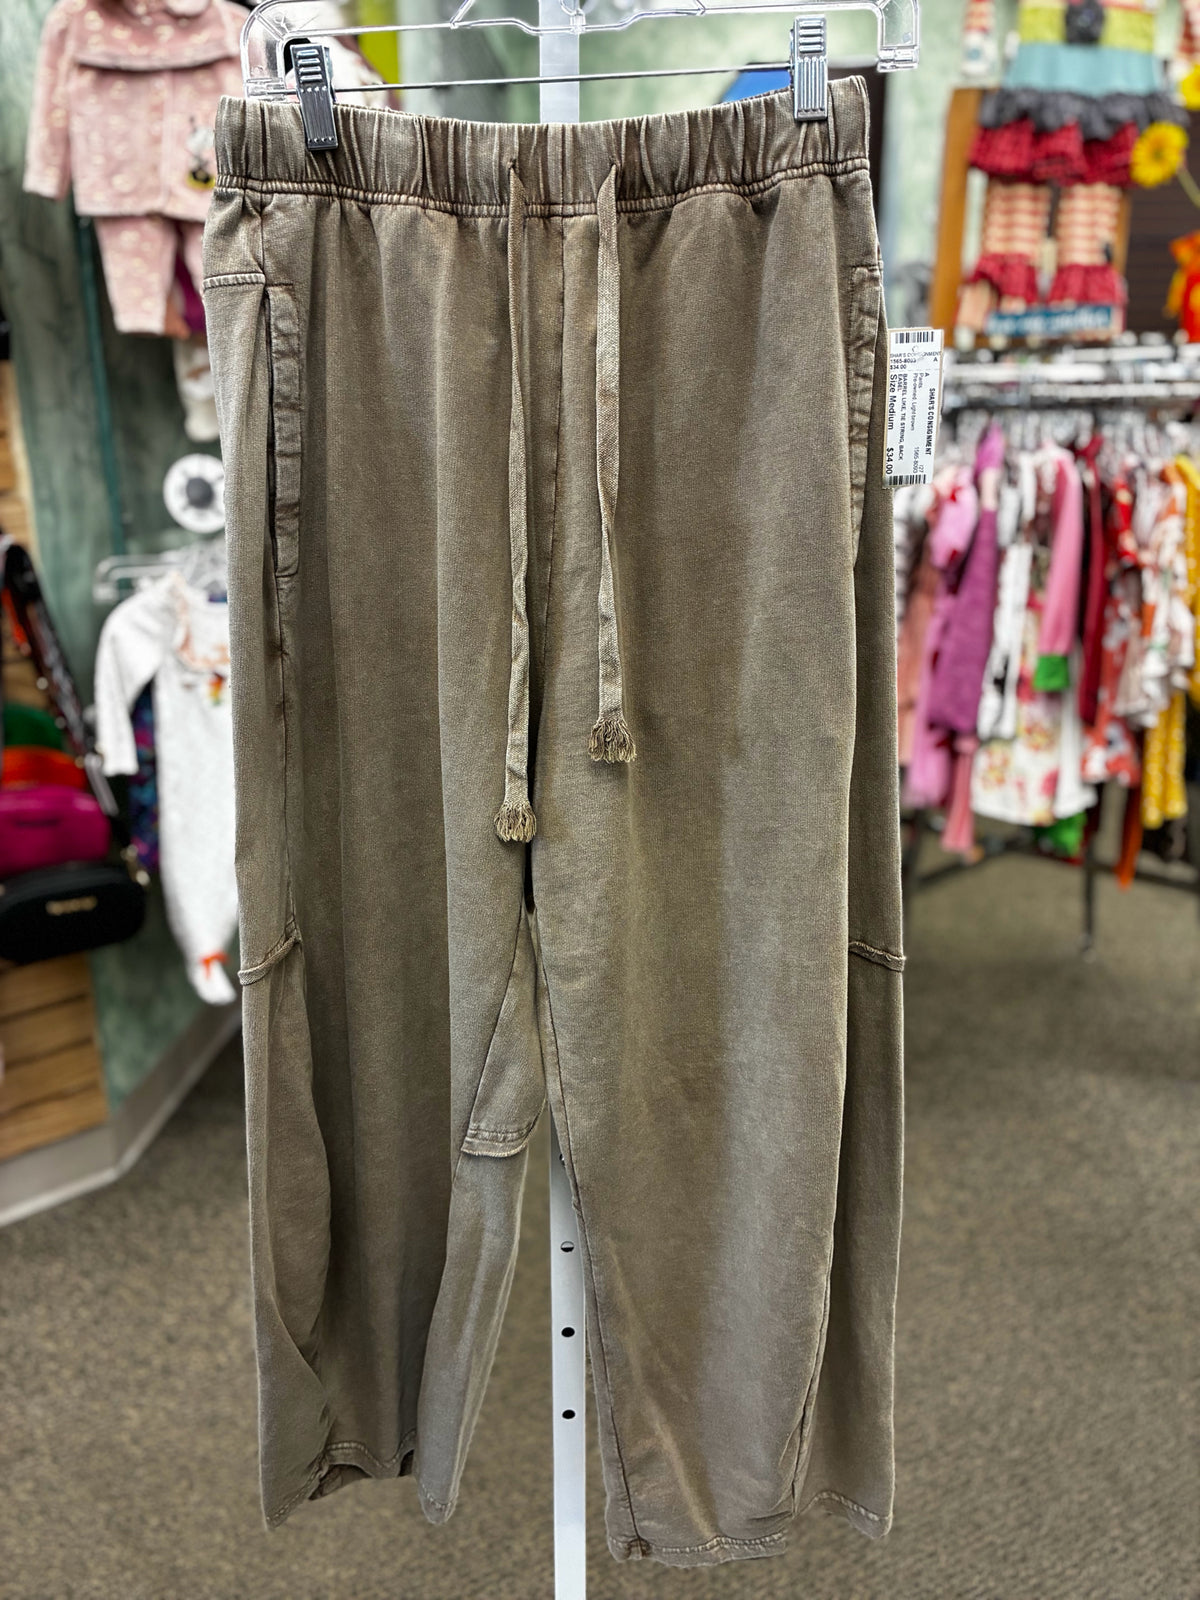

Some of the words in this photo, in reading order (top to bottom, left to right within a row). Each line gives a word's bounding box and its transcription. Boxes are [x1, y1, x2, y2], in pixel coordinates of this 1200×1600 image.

[890, 374, 898, 393] Size
[888, 395, 897, 430] Medium
[928, 387, 936, 410] SHAR'S
[925, 411, 934, 455] CONSIGNMENT
[886, 447, 894, 475] $34.00
